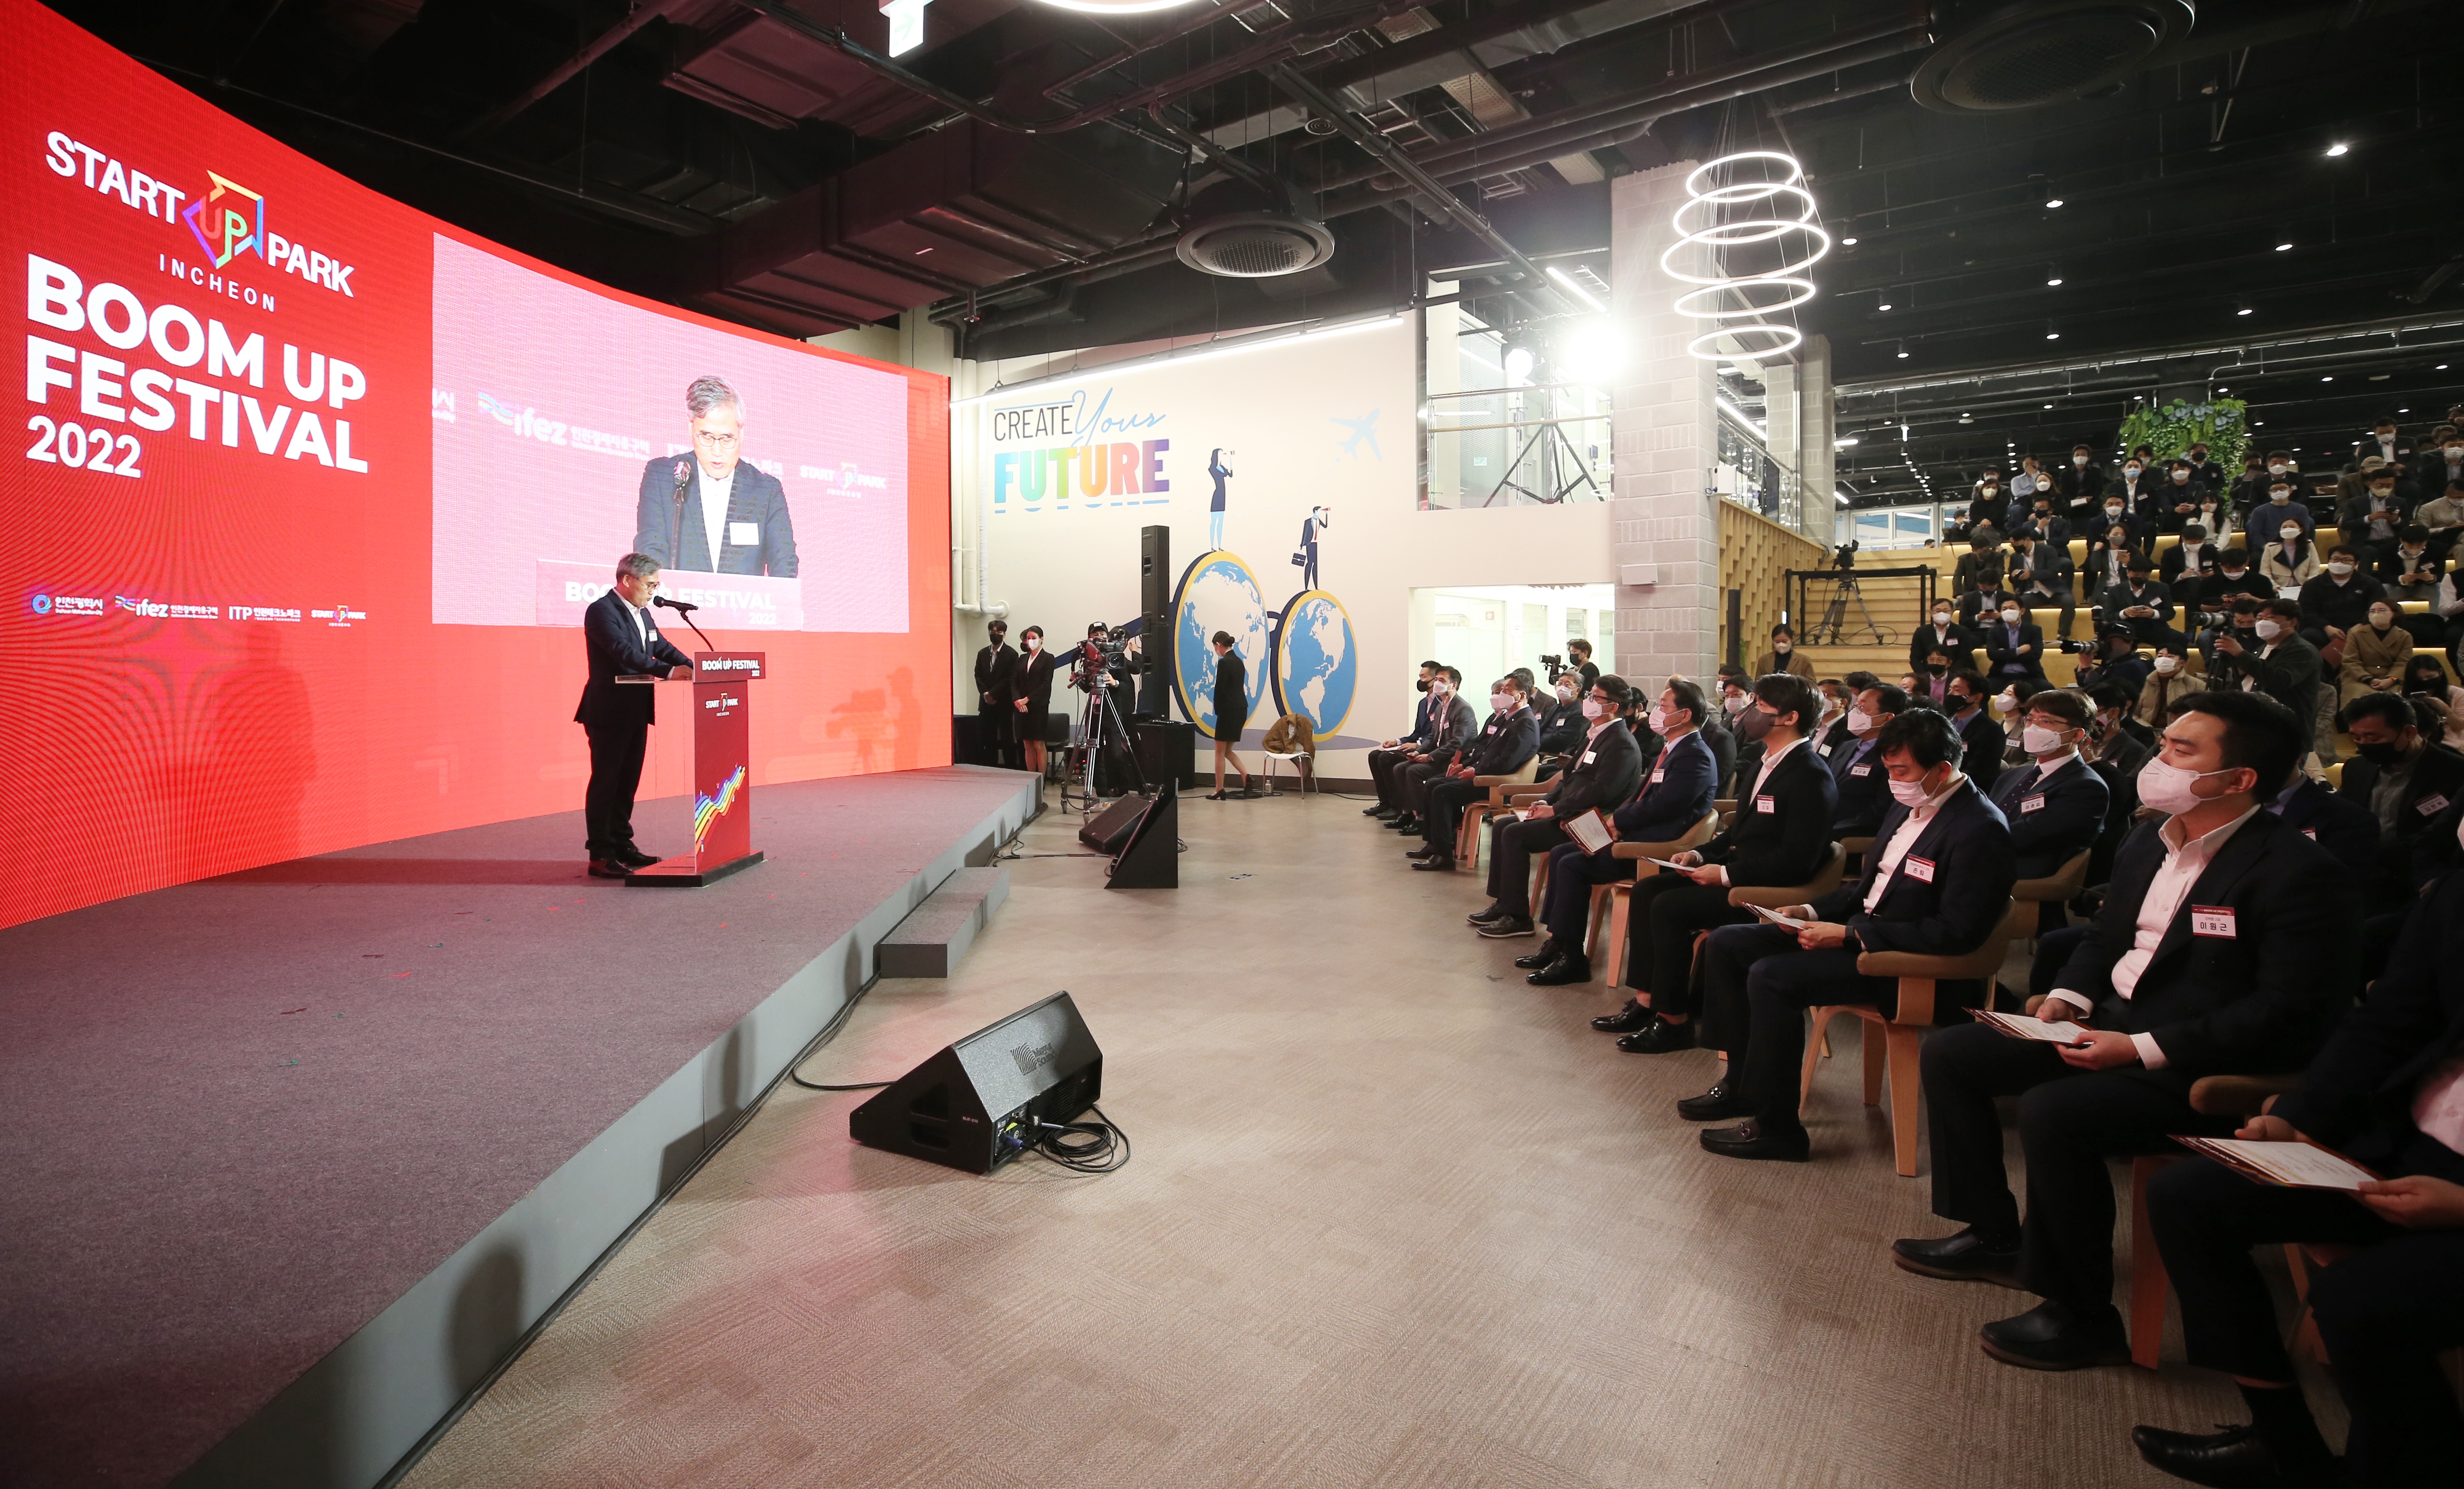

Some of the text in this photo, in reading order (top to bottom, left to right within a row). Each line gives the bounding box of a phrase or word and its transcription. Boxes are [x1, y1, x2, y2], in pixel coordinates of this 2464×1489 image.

[46, 131, 185, 224] START
[268, 232, 354, 298] PARK
[159, 253, 275, 312] INCHEON
[28, 253, 366, 410] BOOM UP
[27, 335, 368, 473] FESTIVAL
[514, 407, 567, 445] ifez
[994, 404, 1073, 441] CREATE
[26, 415, 141, 478] 2022
[800, 465, 835, 481] START
[857, 474, 887, 489] PARK
[994, 439, 1169, 503] FUTURE
[55, 596, 103, 609] 인천광역시
[136, 598, 169, 618] ifez
[679, 587, 776, 610] FESTIVAL
[229, 606, 252, 620] ITP
[253, 607, 301, 618] 인천테크노파크
[311, 609, 334, 619] START
[347, 611, 366, 619] PARK
[748, 612, 776, 625] 2022
[702, 660, 760, 671] BOOM UP FESTIVAL
[706, 700, 720, 709] START
[727, 698, 739, 706] PARK
